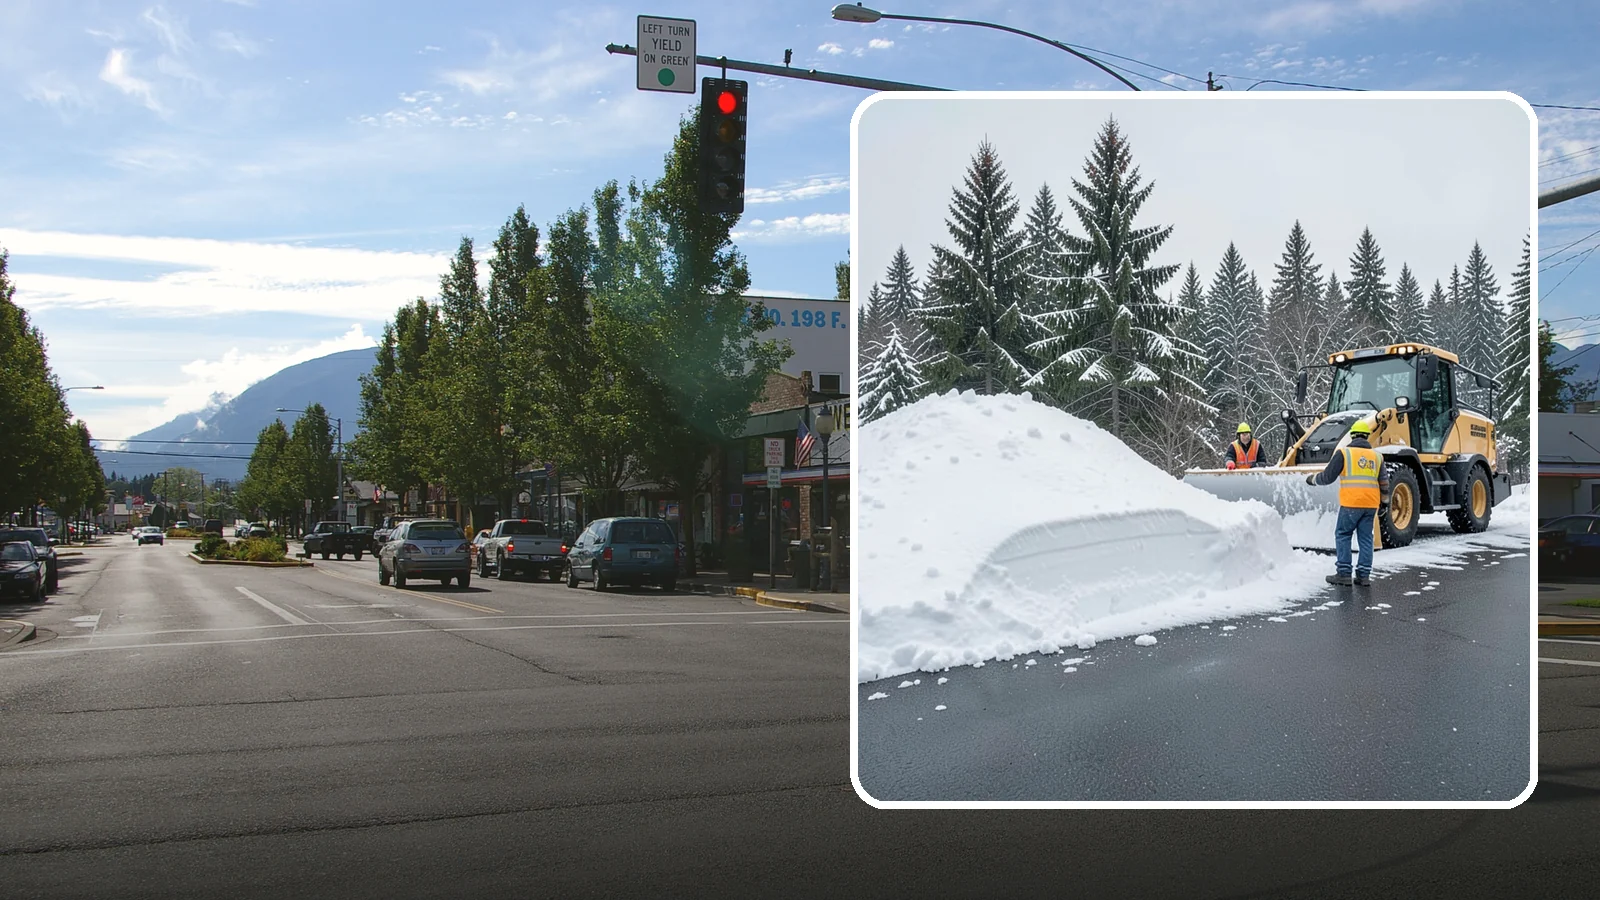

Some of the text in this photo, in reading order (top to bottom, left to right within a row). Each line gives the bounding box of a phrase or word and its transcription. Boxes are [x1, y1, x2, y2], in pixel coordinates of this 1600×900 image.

[643, 23, 690, 37] LEFT TURN
[652, 37, 682, 52] YIELD
[644, 53, 689, 66] ON GREEN
[791, 309, 826, 328] 198
[831, 311, 846, 329] F.
